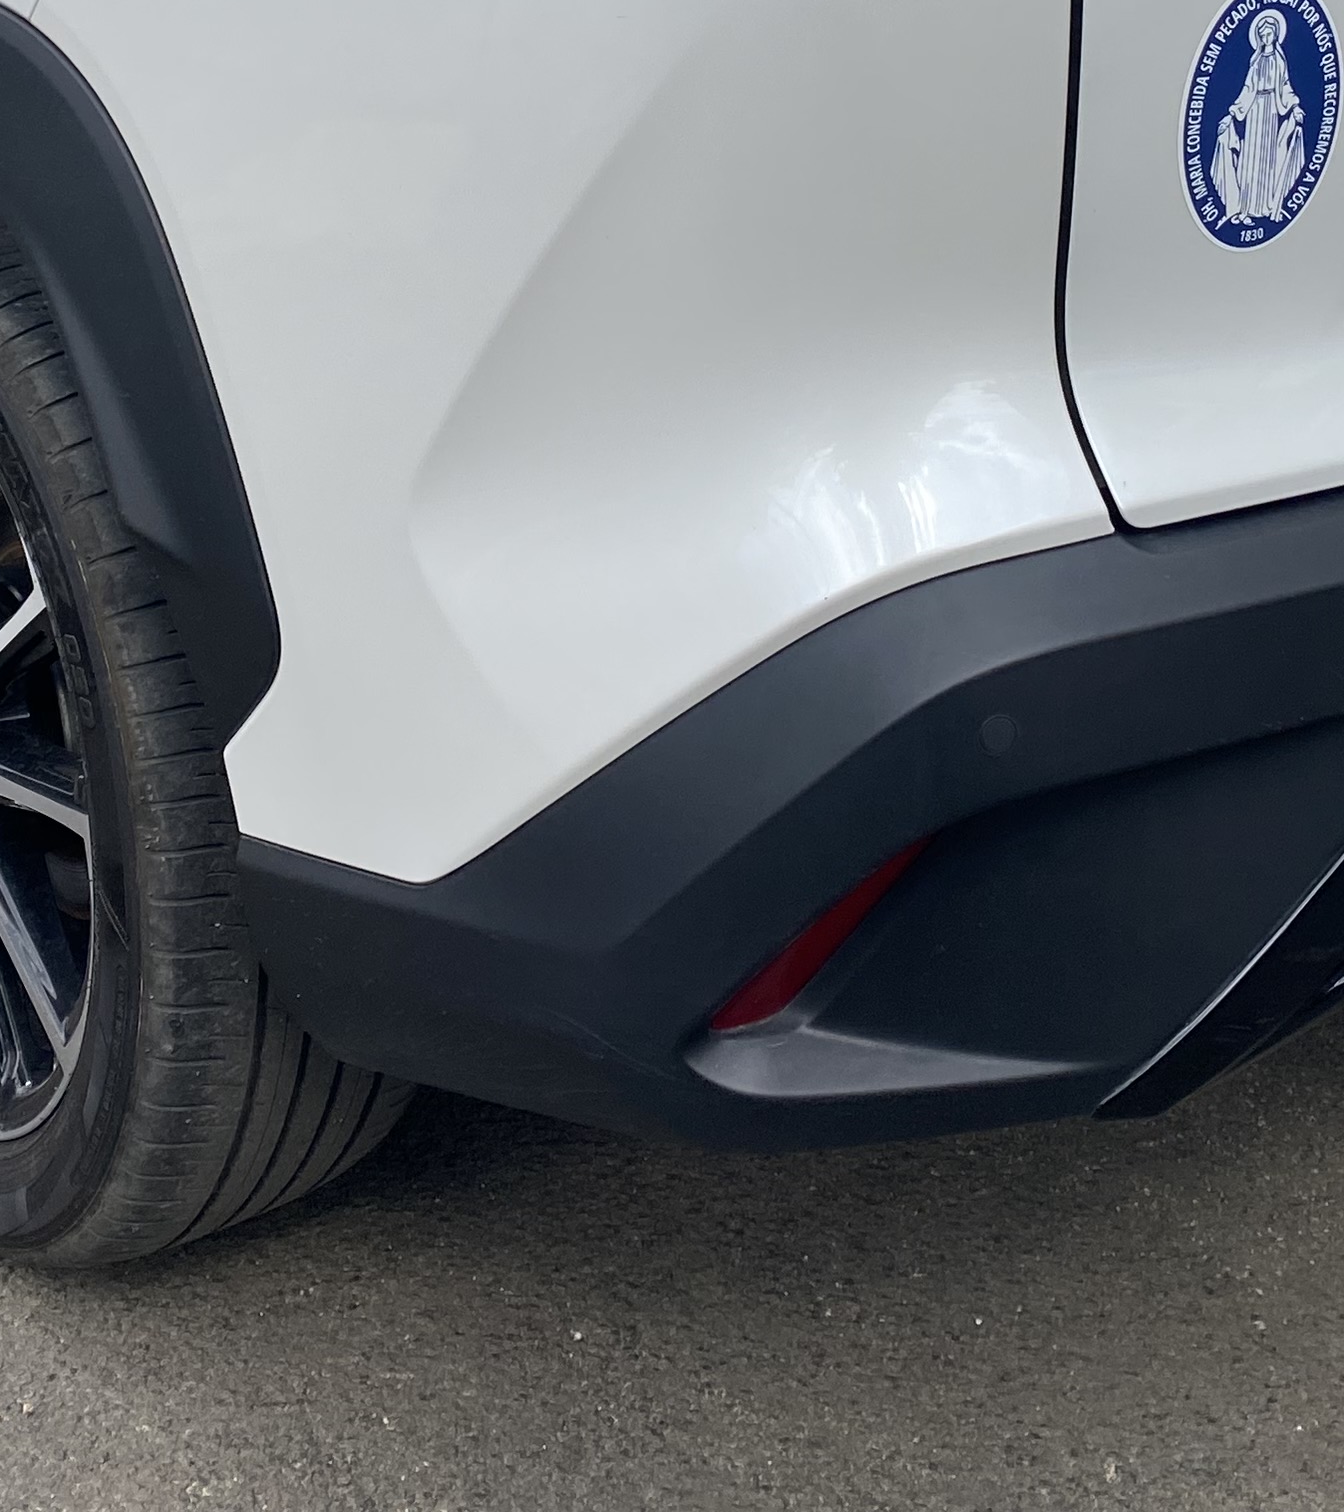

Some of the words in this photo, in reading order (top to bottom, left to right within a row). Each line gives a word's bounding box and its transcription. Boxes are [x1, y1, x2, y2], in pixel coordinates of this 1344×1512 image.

[1297, 0, 1320, 28] POR
[1312, 23, 1334, 53] NÓS
[1200, 43, 1222, 74] SEM
[1319, 53, 1336, 82] QUE
[1186, 76, 1210, 153] CONCEBIDA
[1308, 82, 1337, 172] RECORREMOS
[1188, 154, 1208, 200] MARIA
[1302, 172, 1316, 183] A
[1287, 186, 1310, 212] VÓS
[1240, 227, 1264, 242] 1830
